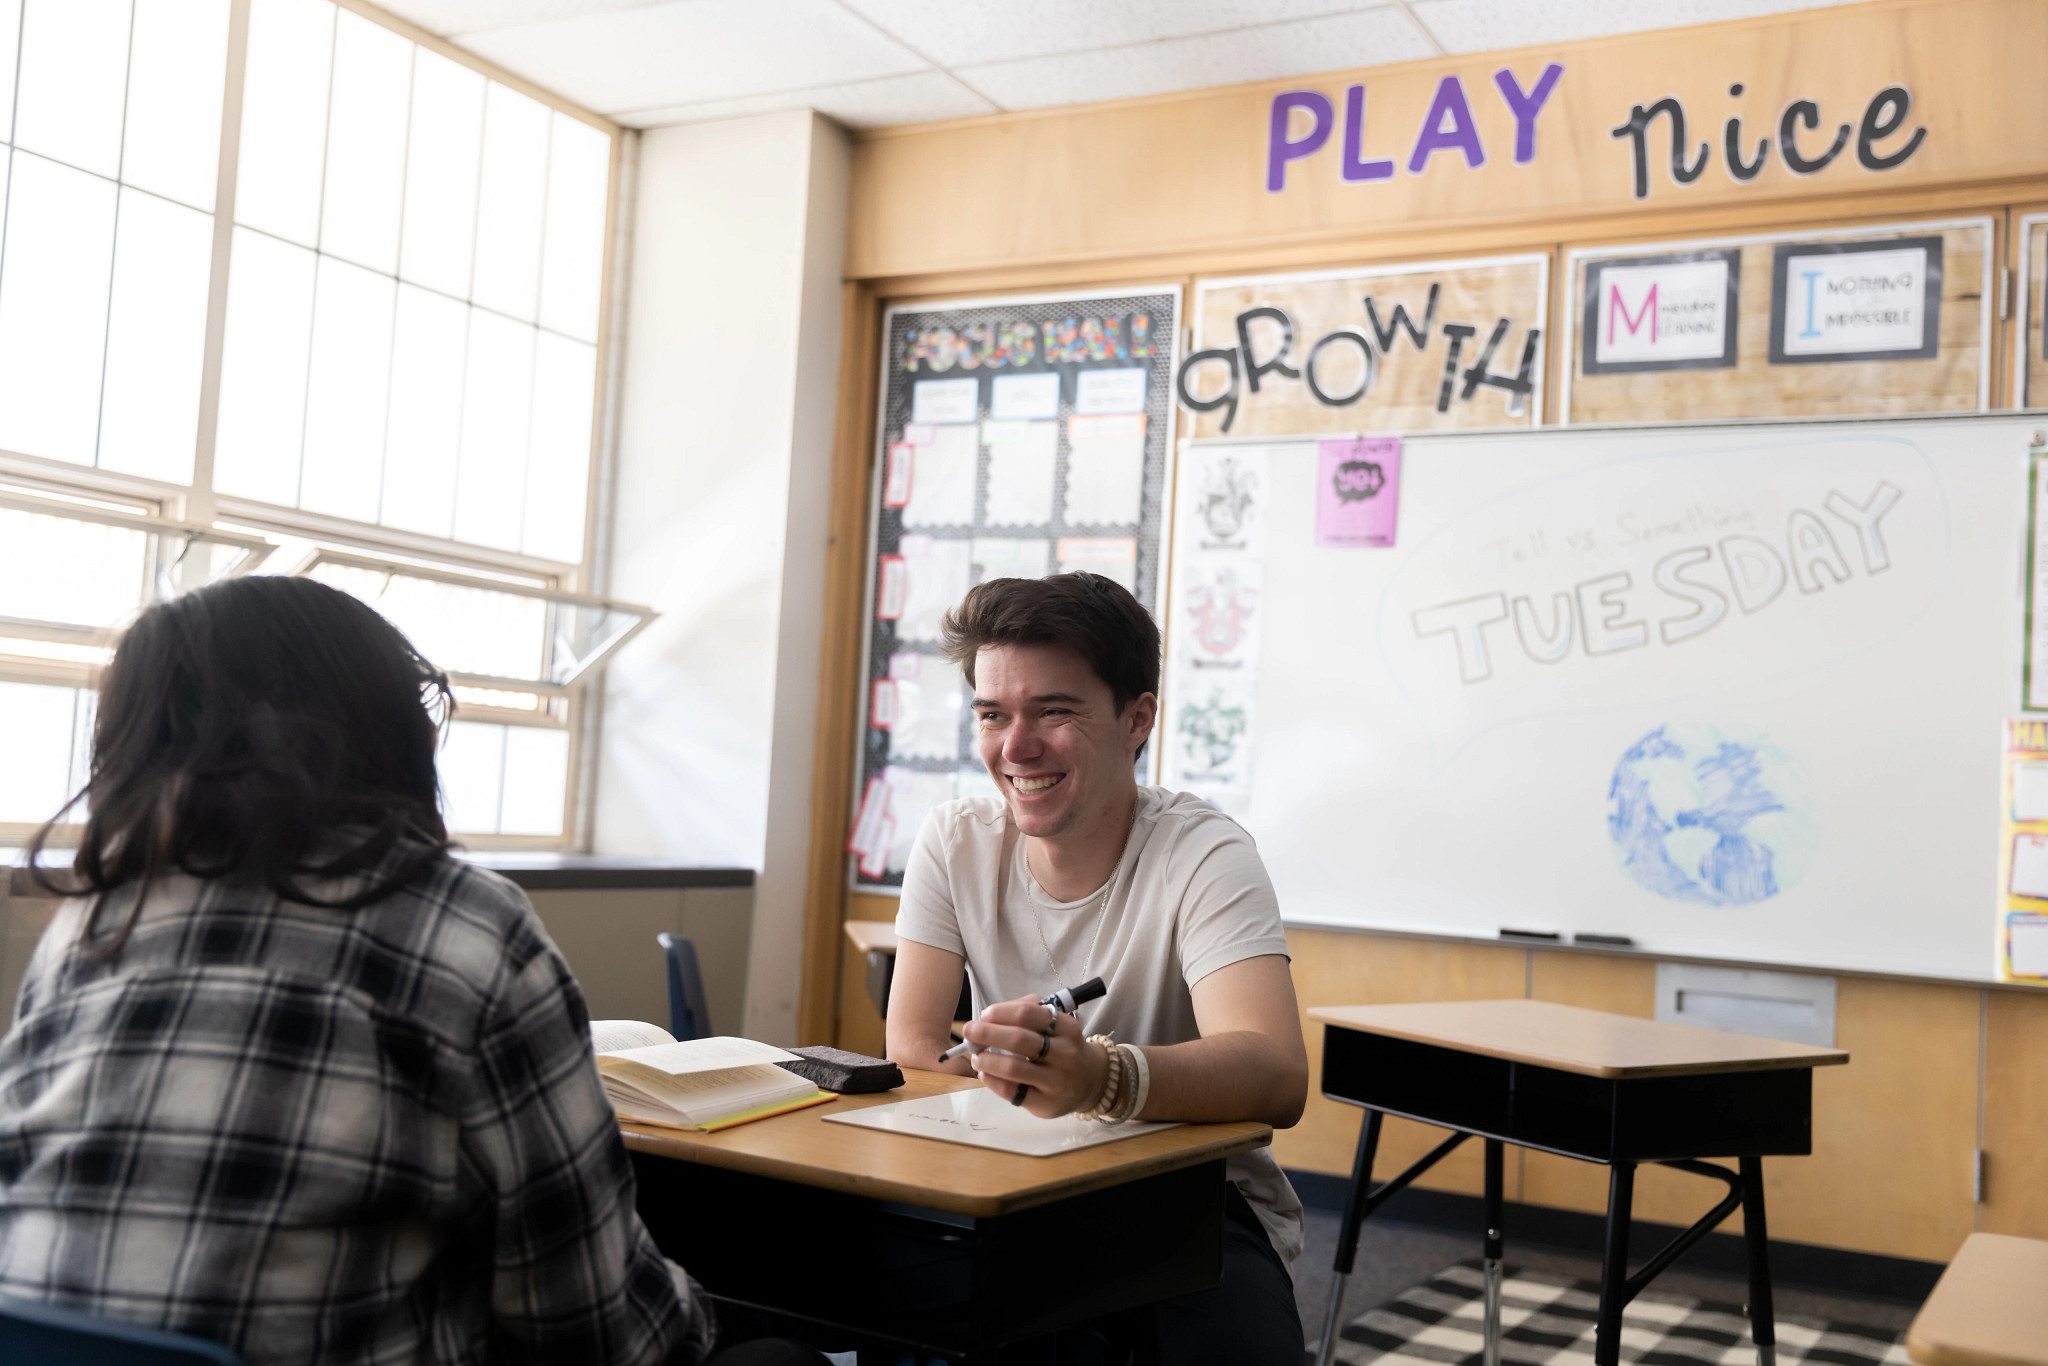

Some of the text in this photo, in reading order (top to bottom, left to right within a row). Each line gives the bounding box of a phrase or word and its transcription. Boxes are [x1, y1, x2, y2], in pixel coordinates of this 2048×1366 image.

[1266, 62, 1928, 199] PLAY nice
[1608, 283, 1657, 345] M
[1799, 271, 1824, 338] I
[1411, 479, 1904, 684] TUESDAY
